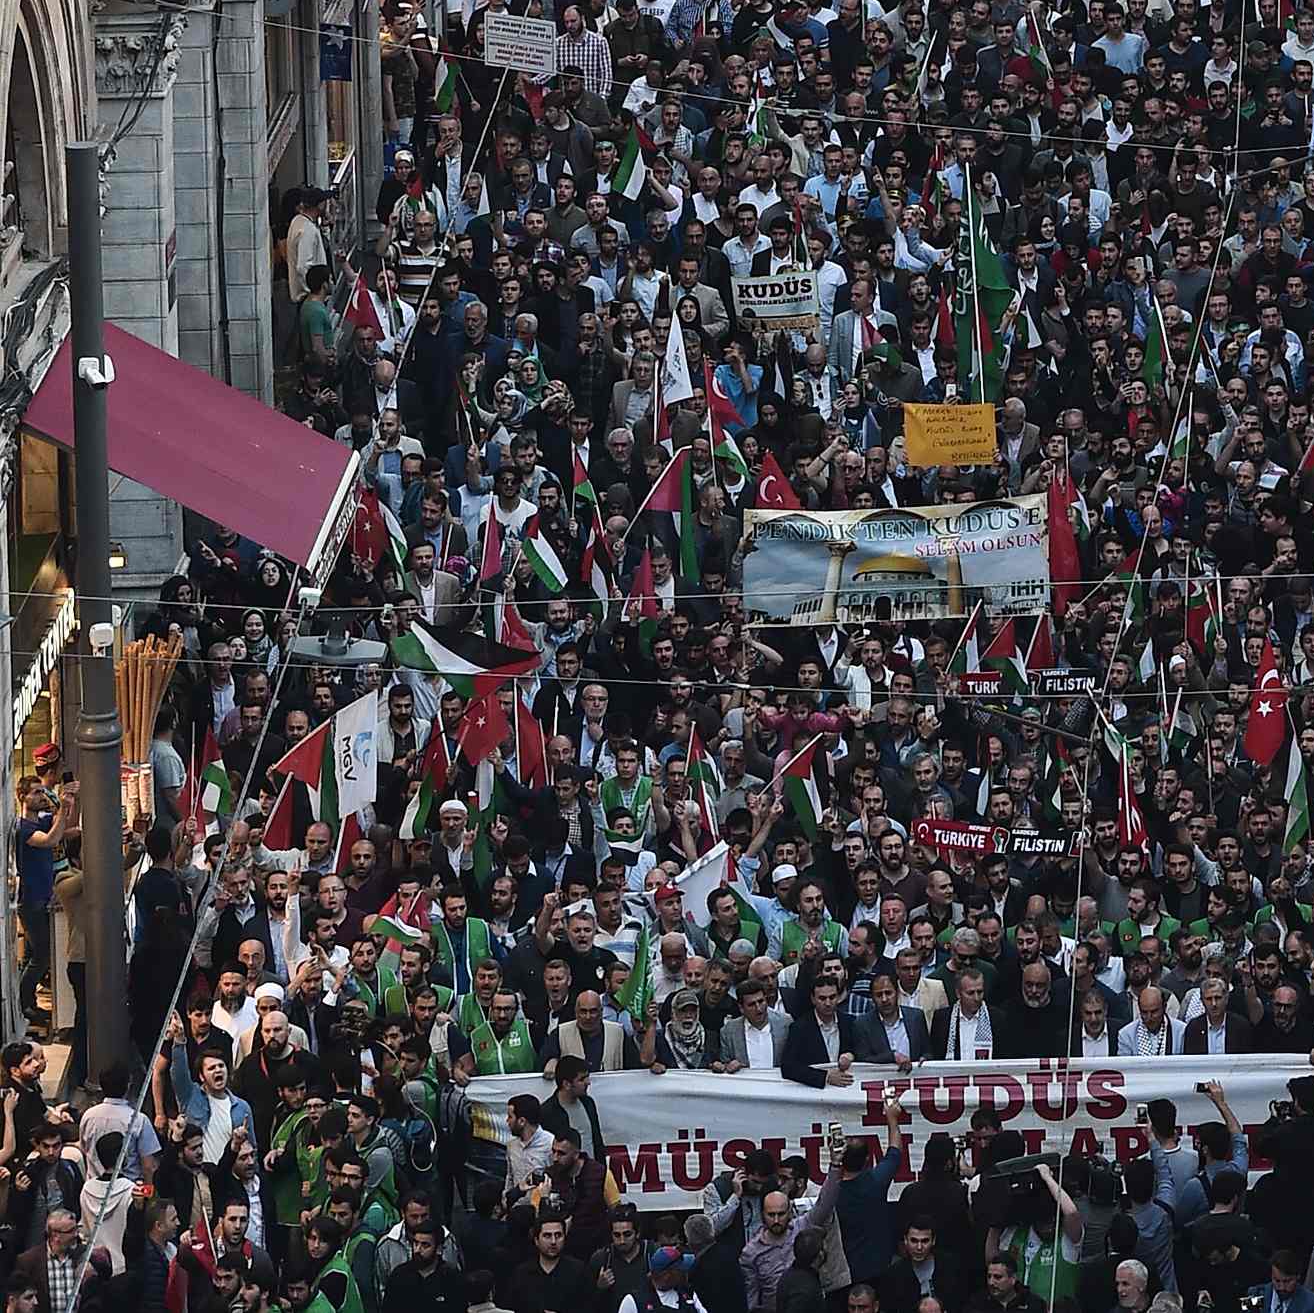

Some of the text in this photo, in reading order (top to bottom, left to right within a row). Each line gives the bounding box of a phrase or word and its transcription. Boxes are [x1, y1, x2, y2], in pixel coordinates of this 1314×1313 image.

[736, 276, 813, 298] KUDÜS
[752, 506, 1042, 542] PENDİK'TEN KUDÜS'E
[981, 532, 1042, 553] OLSUN
[342, 735, 358, 782] MGV
[933, 829, 986, 848] TÜRKİYE
[1013, 837, 1065, 853] FİLİSTİN
[861, 1056, 1126, 1127] KUDÜS
